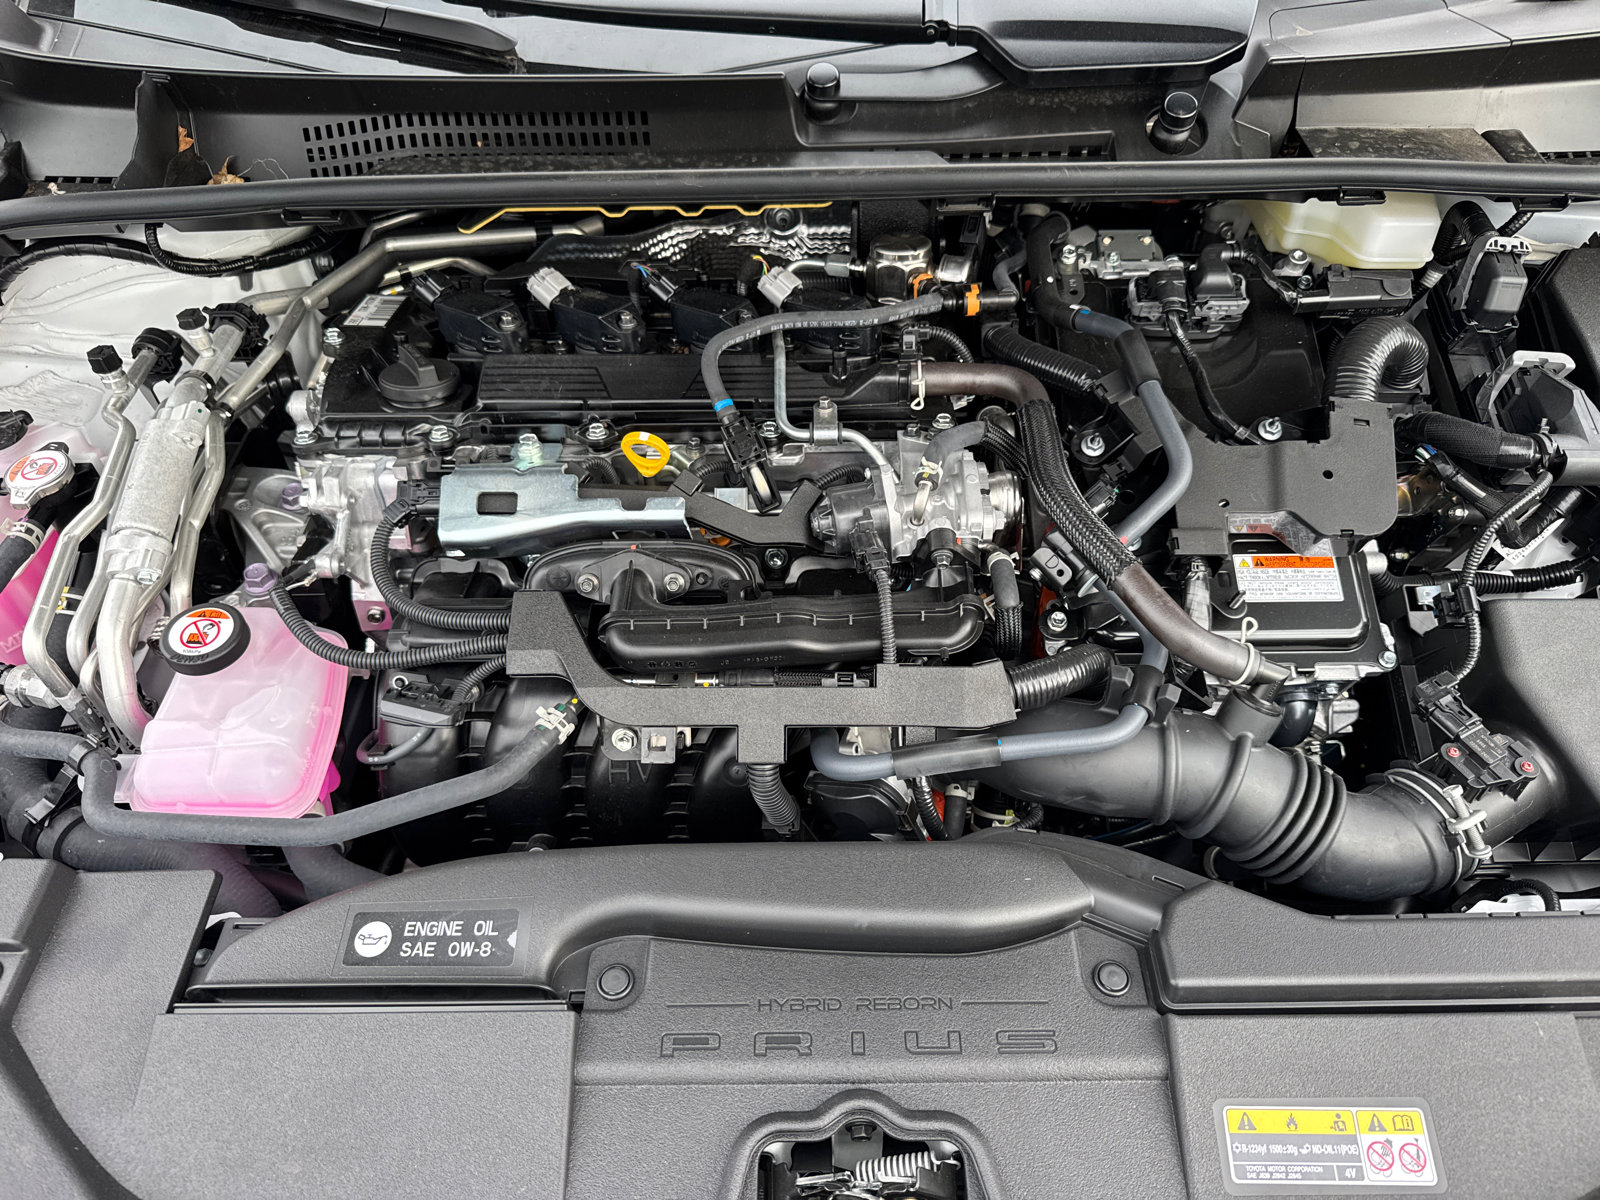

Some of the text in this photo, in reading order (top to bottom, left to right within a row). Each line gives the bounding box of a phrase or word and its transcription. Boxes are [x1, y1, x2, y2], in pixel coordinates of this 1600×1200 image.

[404, 920, 499, 937] ENGINE OIL
[400, 942, 437, 957] SAE
[757, 996, 954, 1012] HYBRID REBORN
[660, 1030, 1058, 1058] PRIUS
[1245, 1165, 1324, 1173] TOYOTA MOTOR CORPORATION
[1345, 1167, 1356, 1179] 4V
